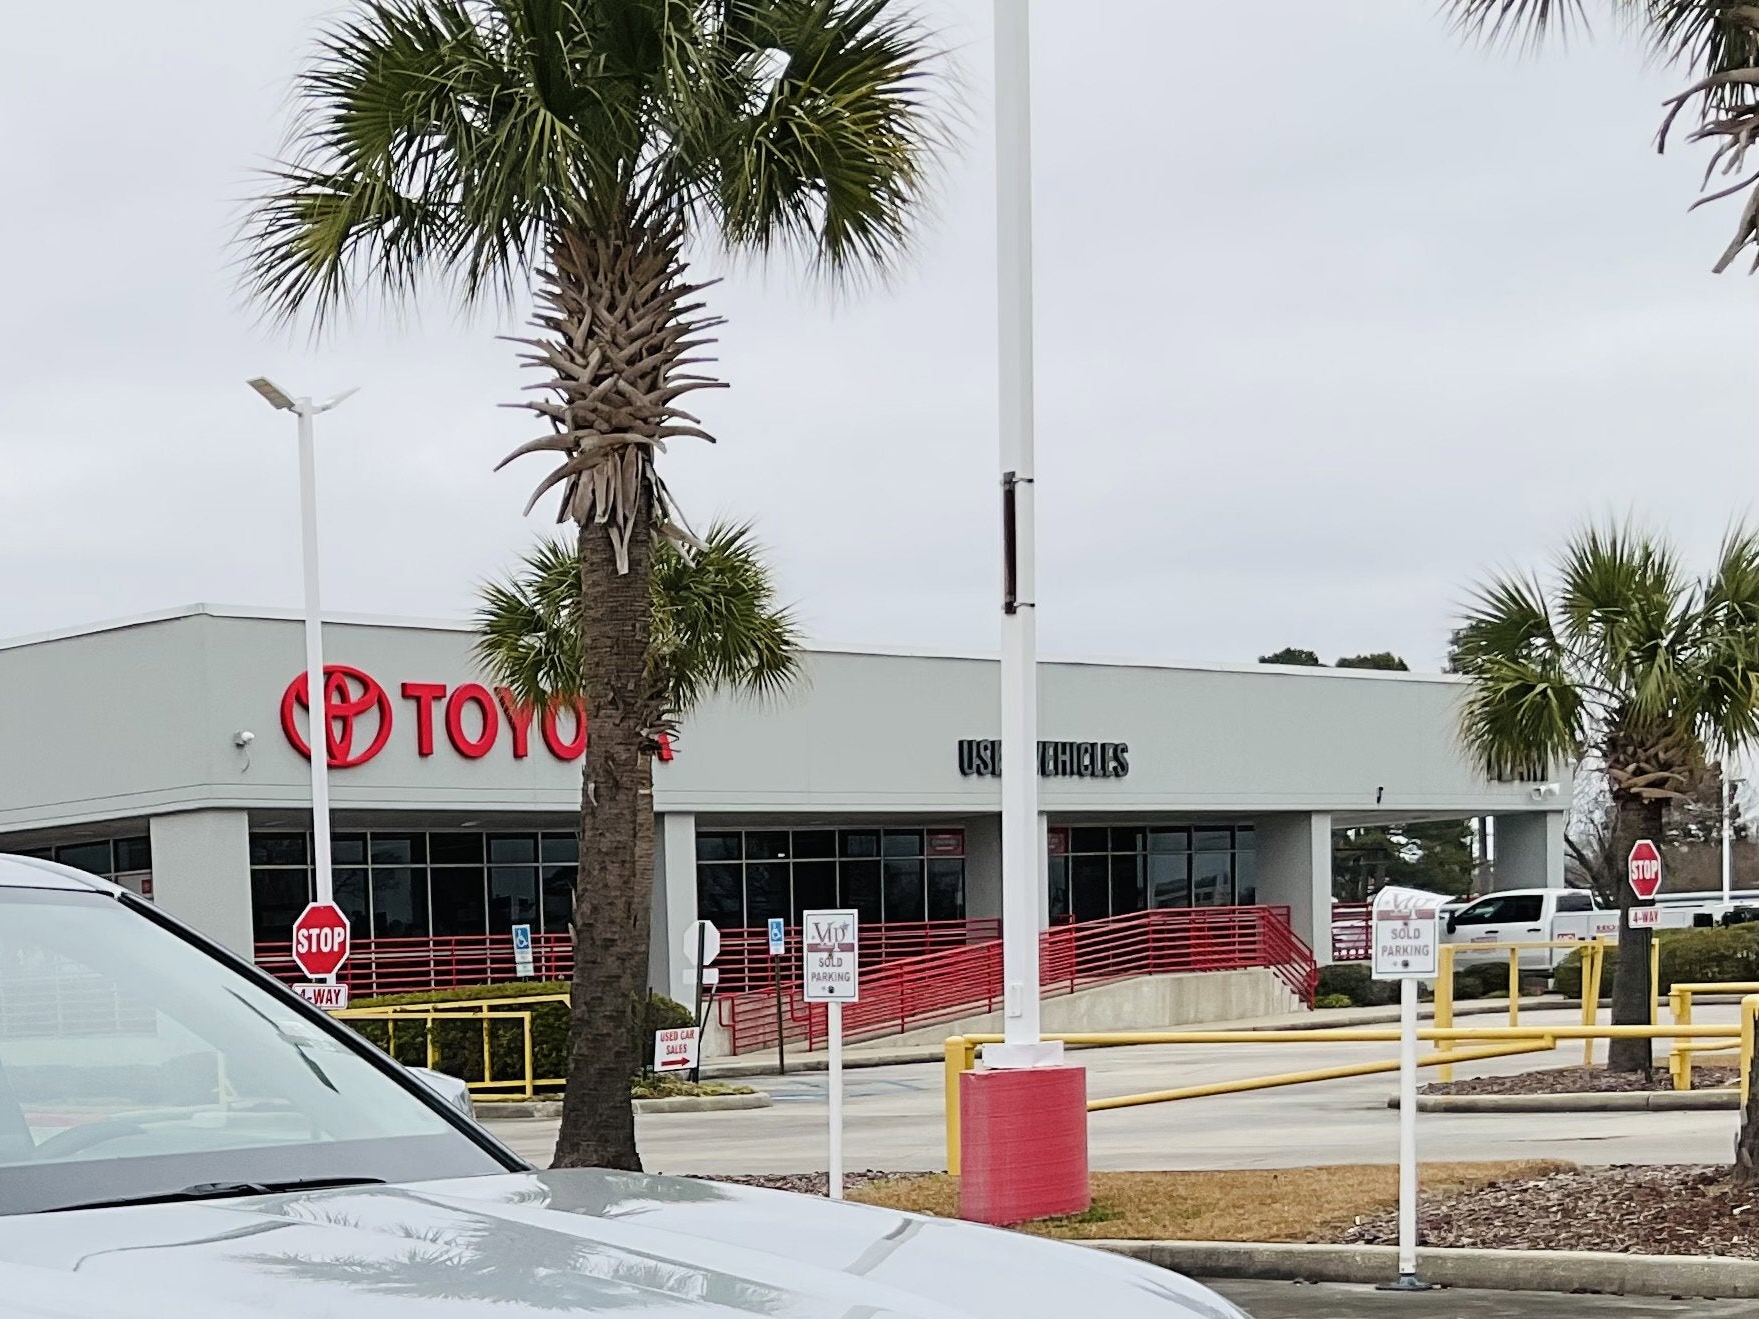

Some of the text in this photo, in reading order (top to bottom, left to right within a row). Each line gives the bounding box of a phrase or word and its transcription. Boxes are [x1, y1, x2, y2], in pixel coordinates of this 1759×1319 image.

[401, 683, 673, 762] TOYO
[958, 739, 1129, 777] USE EHICLES
[1631, 859, 1658, 880] STOP
[1633, 910, 1658, 924] 4-WAY
[297, 926, 345, 954] STOP
[1391, 927, 1421, 940] SOLD
[1381, 944, 1429, 957] PARKING
[818, 957, 843, 968] SOLD
[810, 971, 851, 982] PARKING
[660, 1030, 694, 1042] USED CAR
[666, 1044, 687, 1055] SALES
